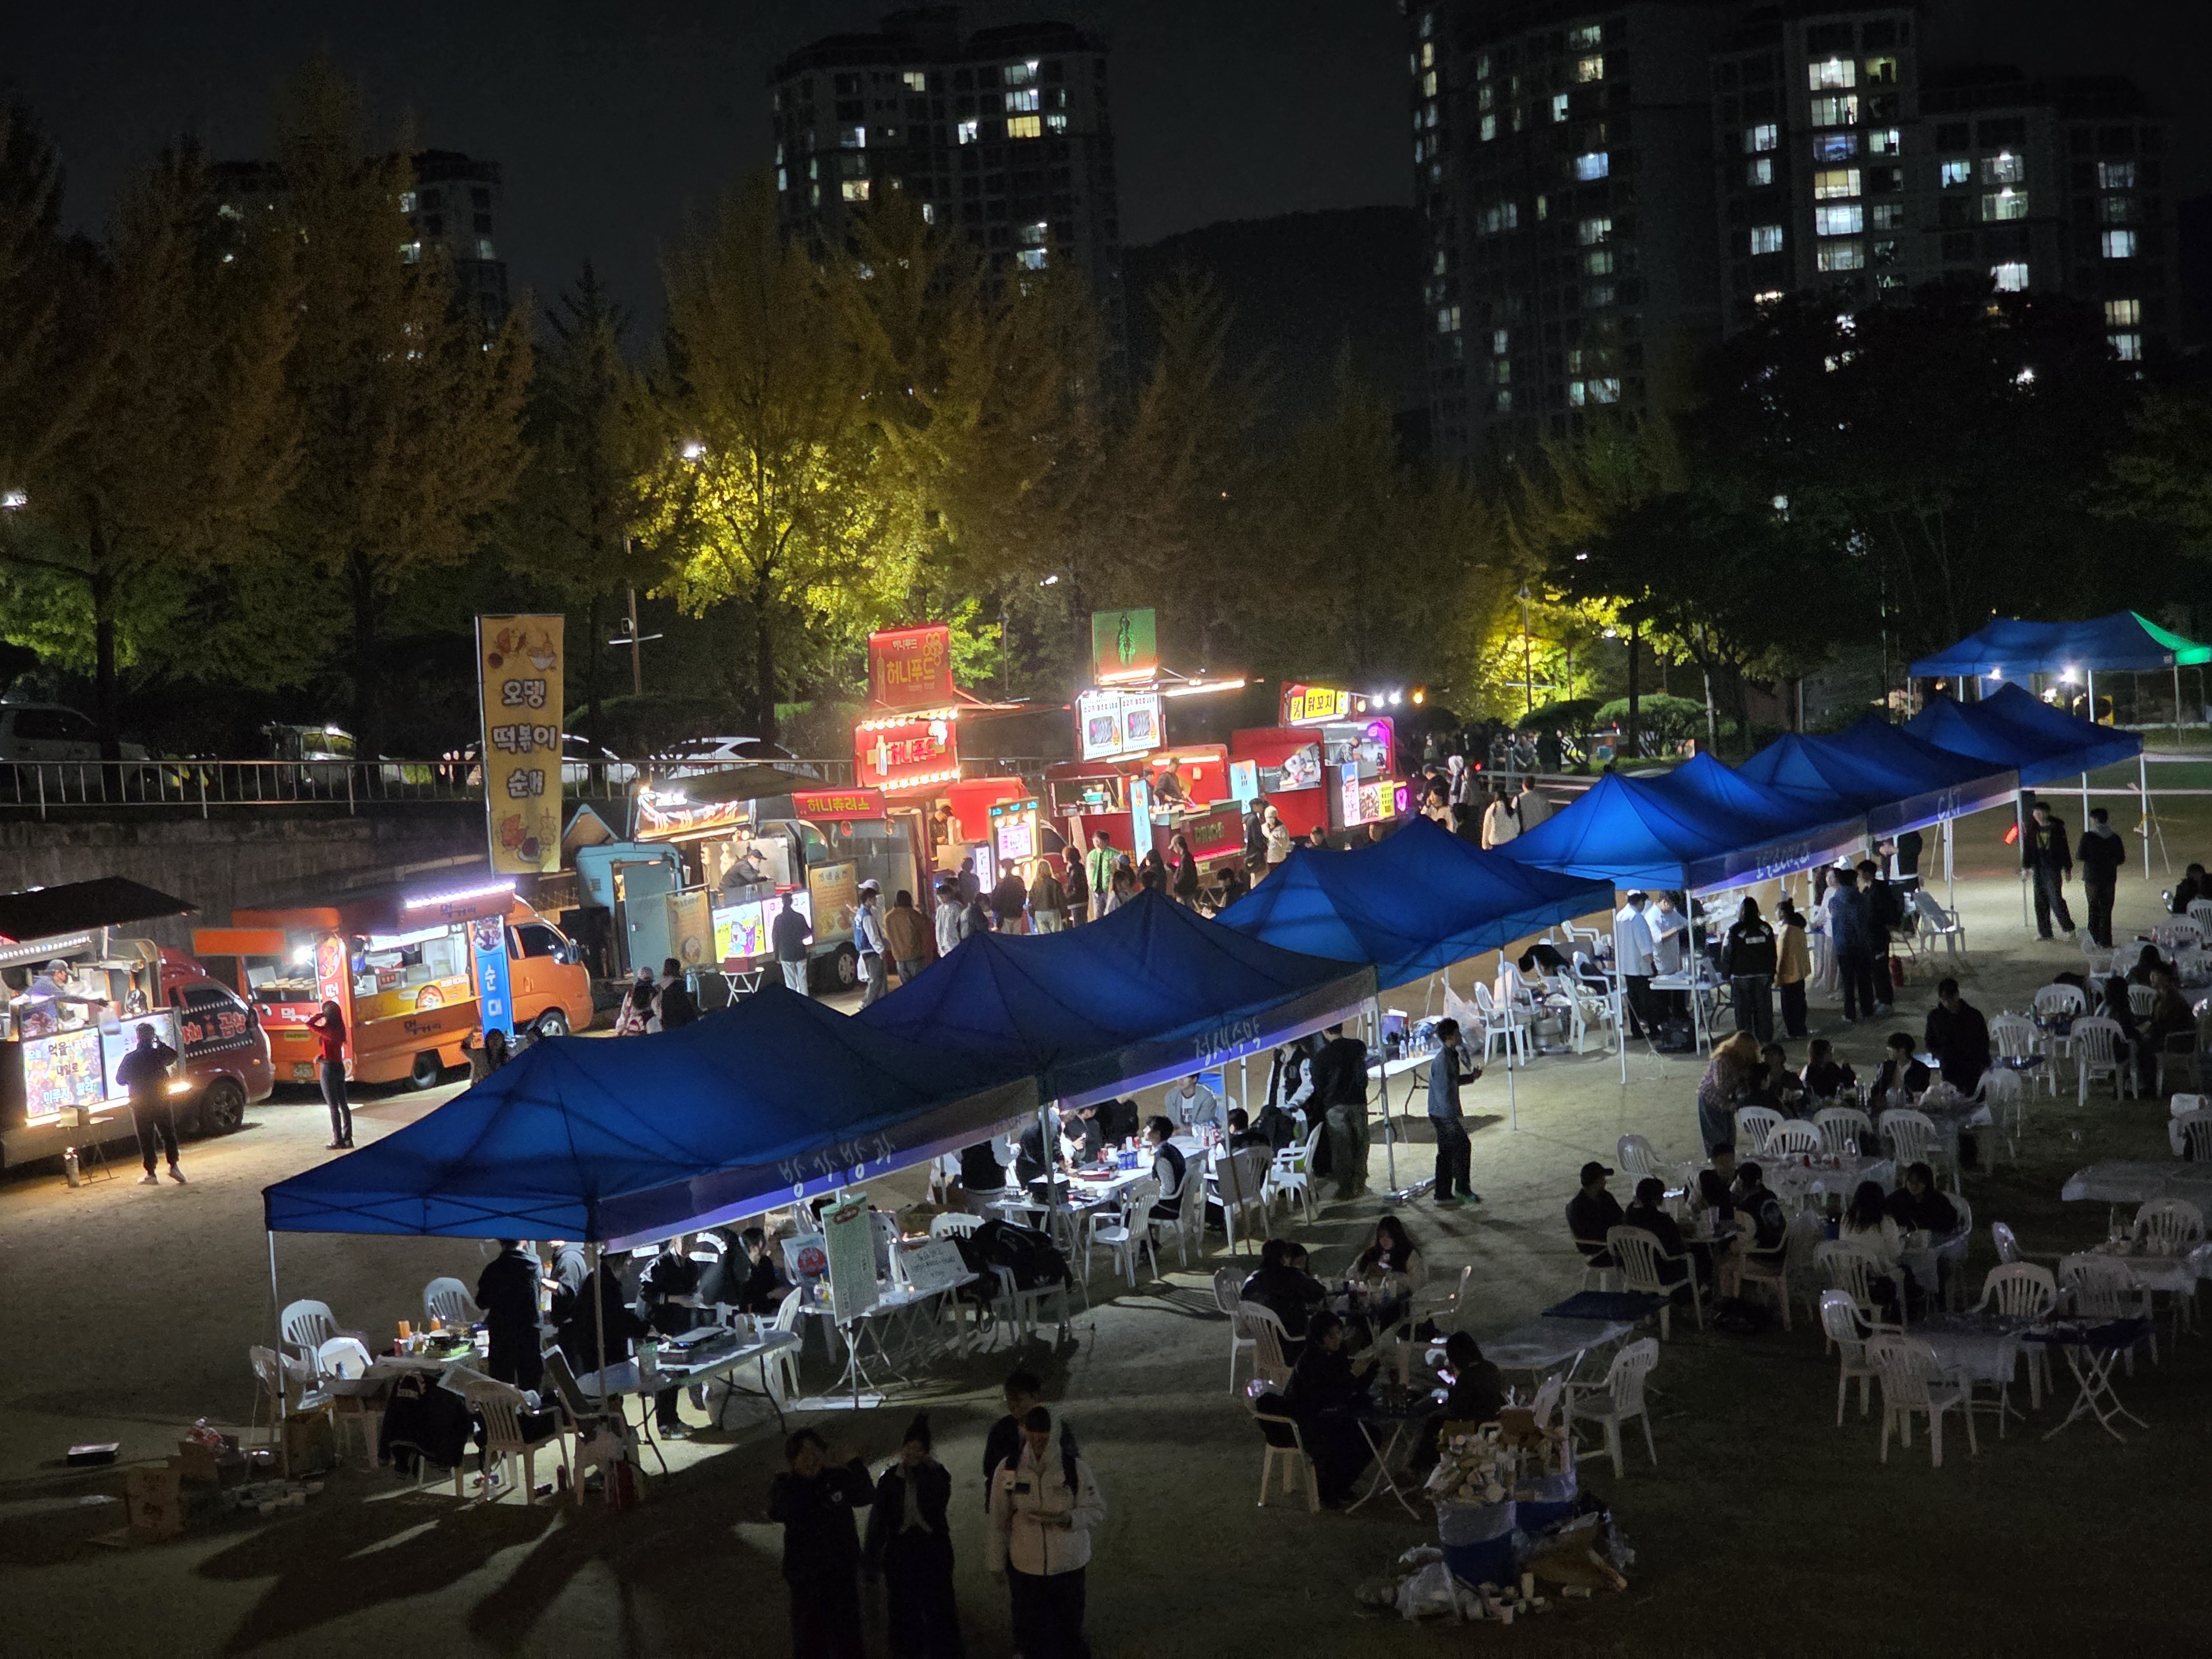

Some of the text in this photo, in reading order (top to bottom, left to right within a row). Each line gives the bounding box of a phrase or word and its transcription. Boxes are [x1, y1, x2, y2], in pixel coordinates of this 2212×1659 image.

[886, 656, 935, 685] 허니푸드
[502, 679, 546, 709] 오뎅
[492, 723, 557, 753] 떡볶이
[889, 738, 937, 765] 허니푸드
[48, 1041, 68, 1057] 먹을
[56, 1062, 80, 1077] 내일로
[43, 1086, 71, 1104] 미루지
